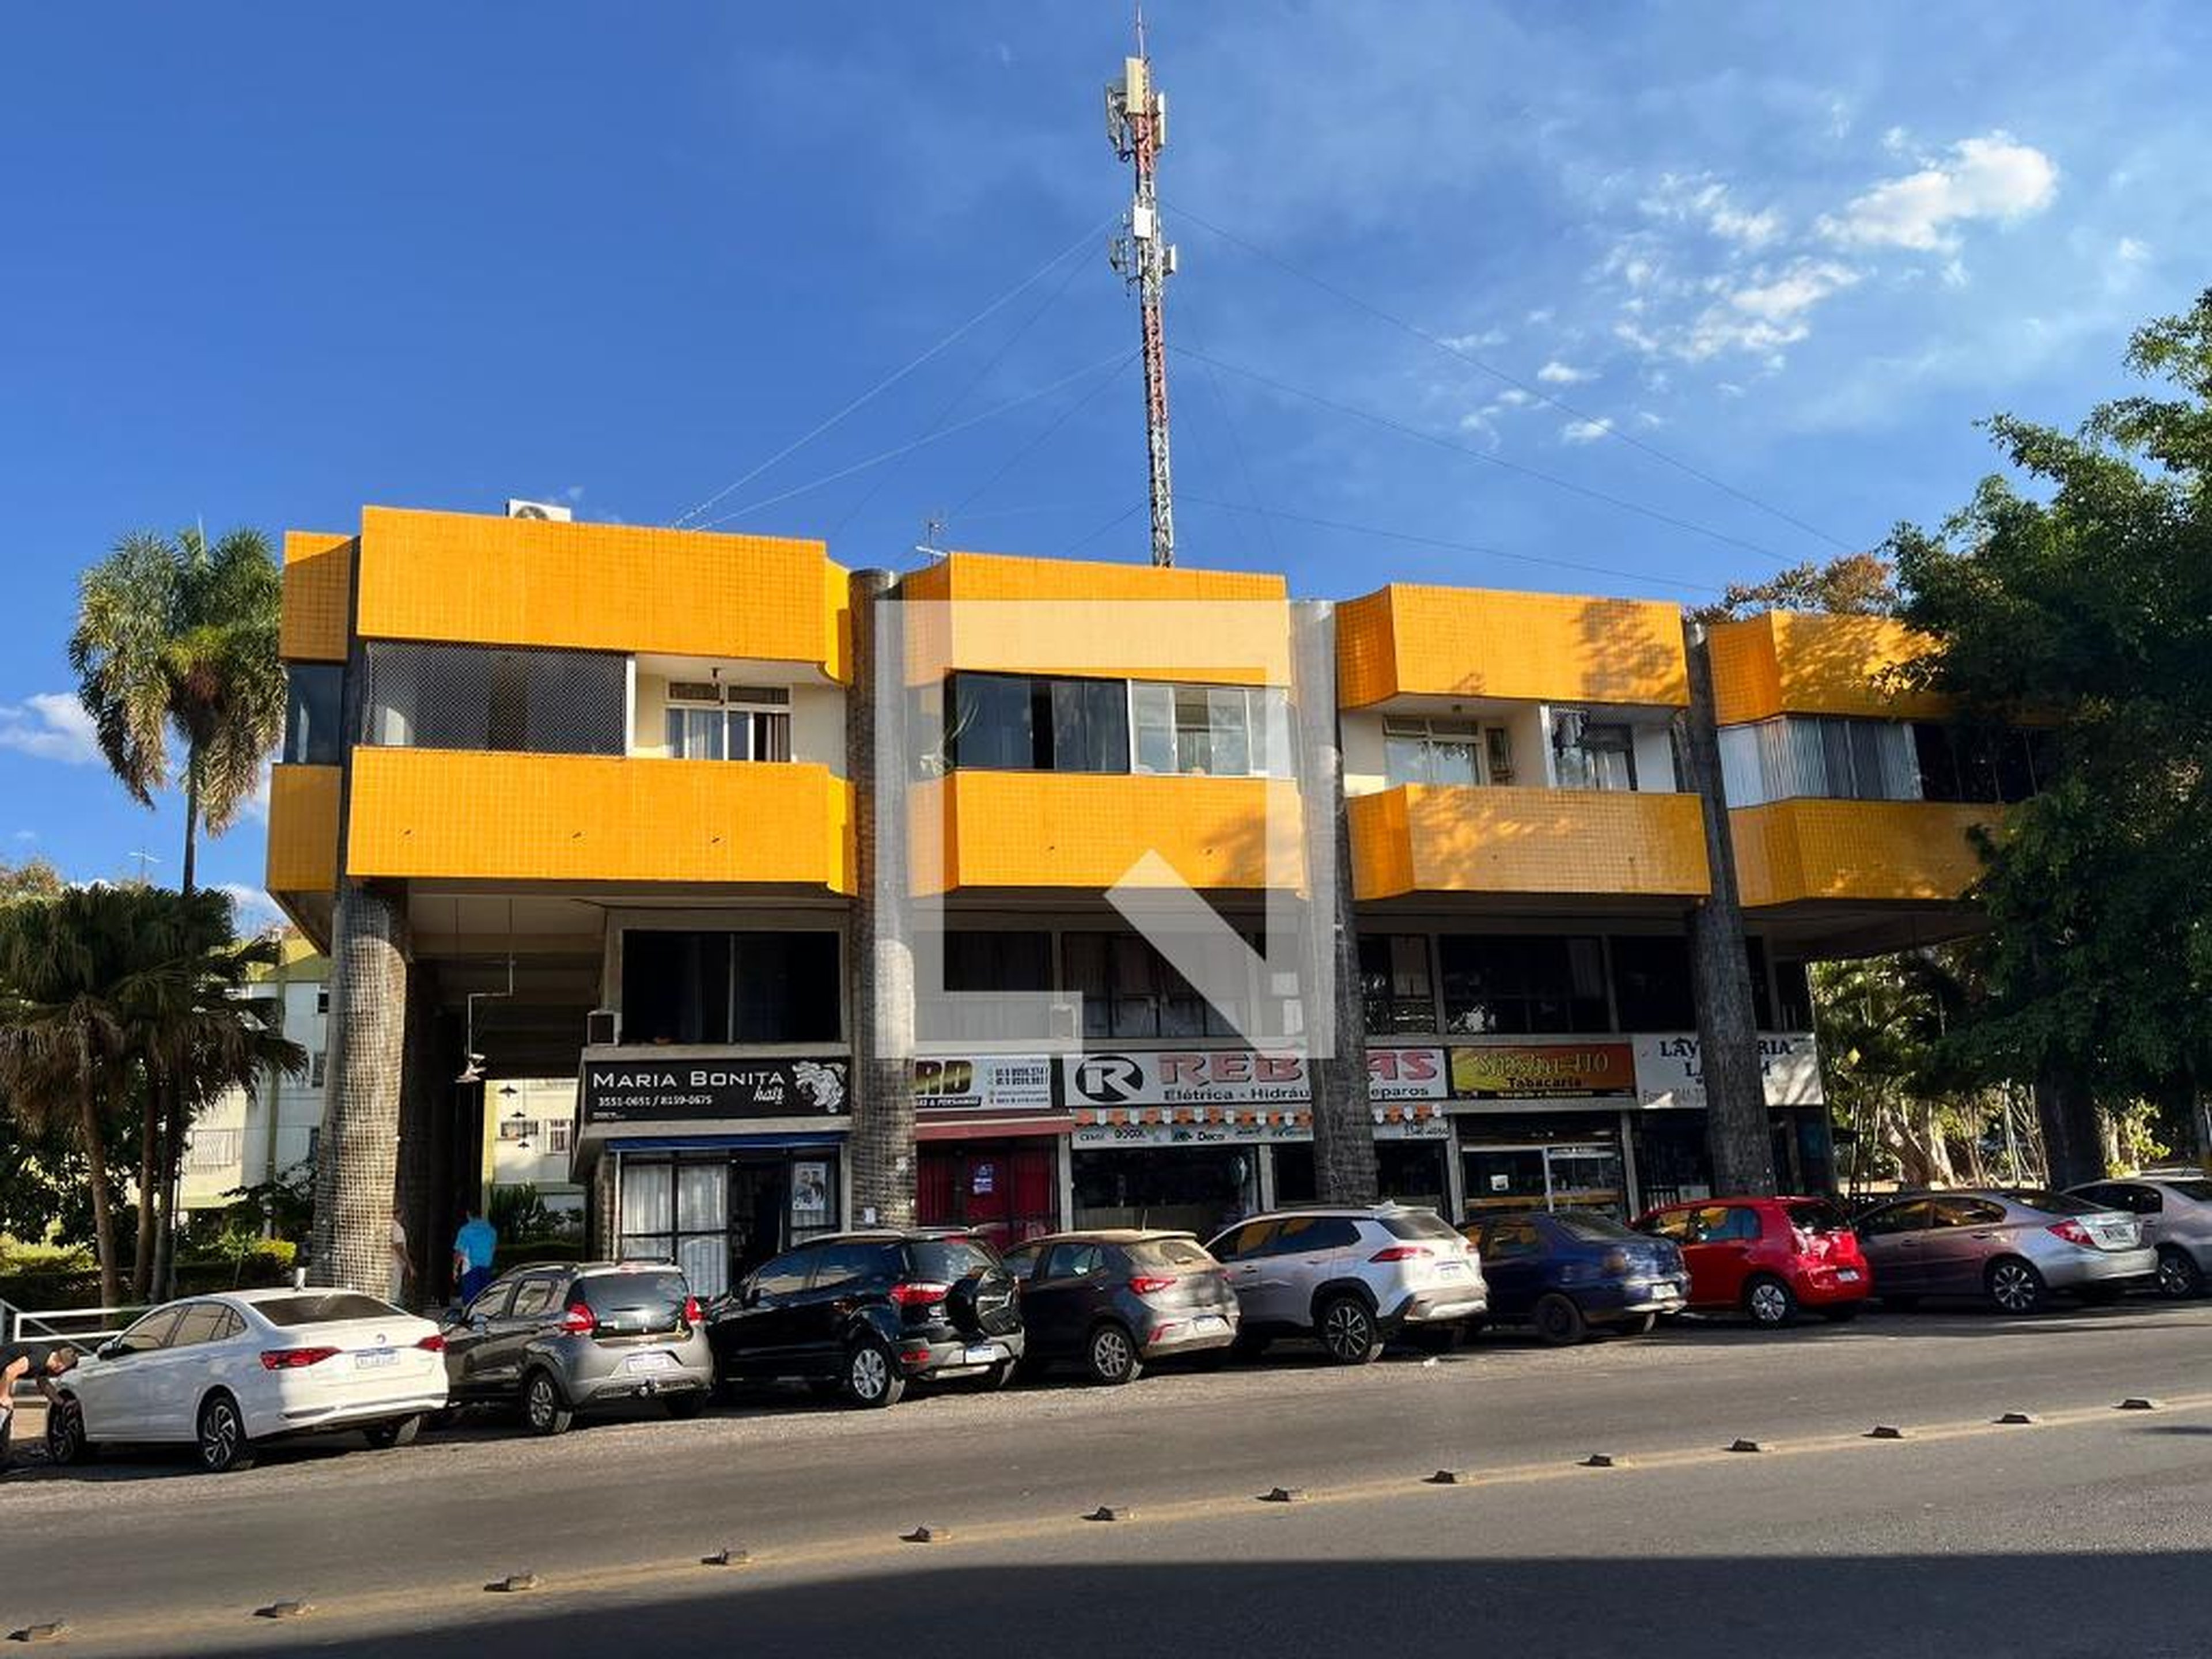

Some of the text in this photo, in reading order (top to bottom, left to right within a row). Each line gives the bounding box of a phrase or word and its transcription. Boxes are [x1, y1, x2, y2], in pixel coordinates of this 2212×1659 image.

[593, 1070, 785, 1088] MARIA BONITA
[1507, 1076, 1582, 1088] Tabacaria
[1164, 1088, 1234, 1101] Elétrica
[1250, 1086, 1311, 1099] Hidráu
[1370, 1088, 1429, 1099] eparos
